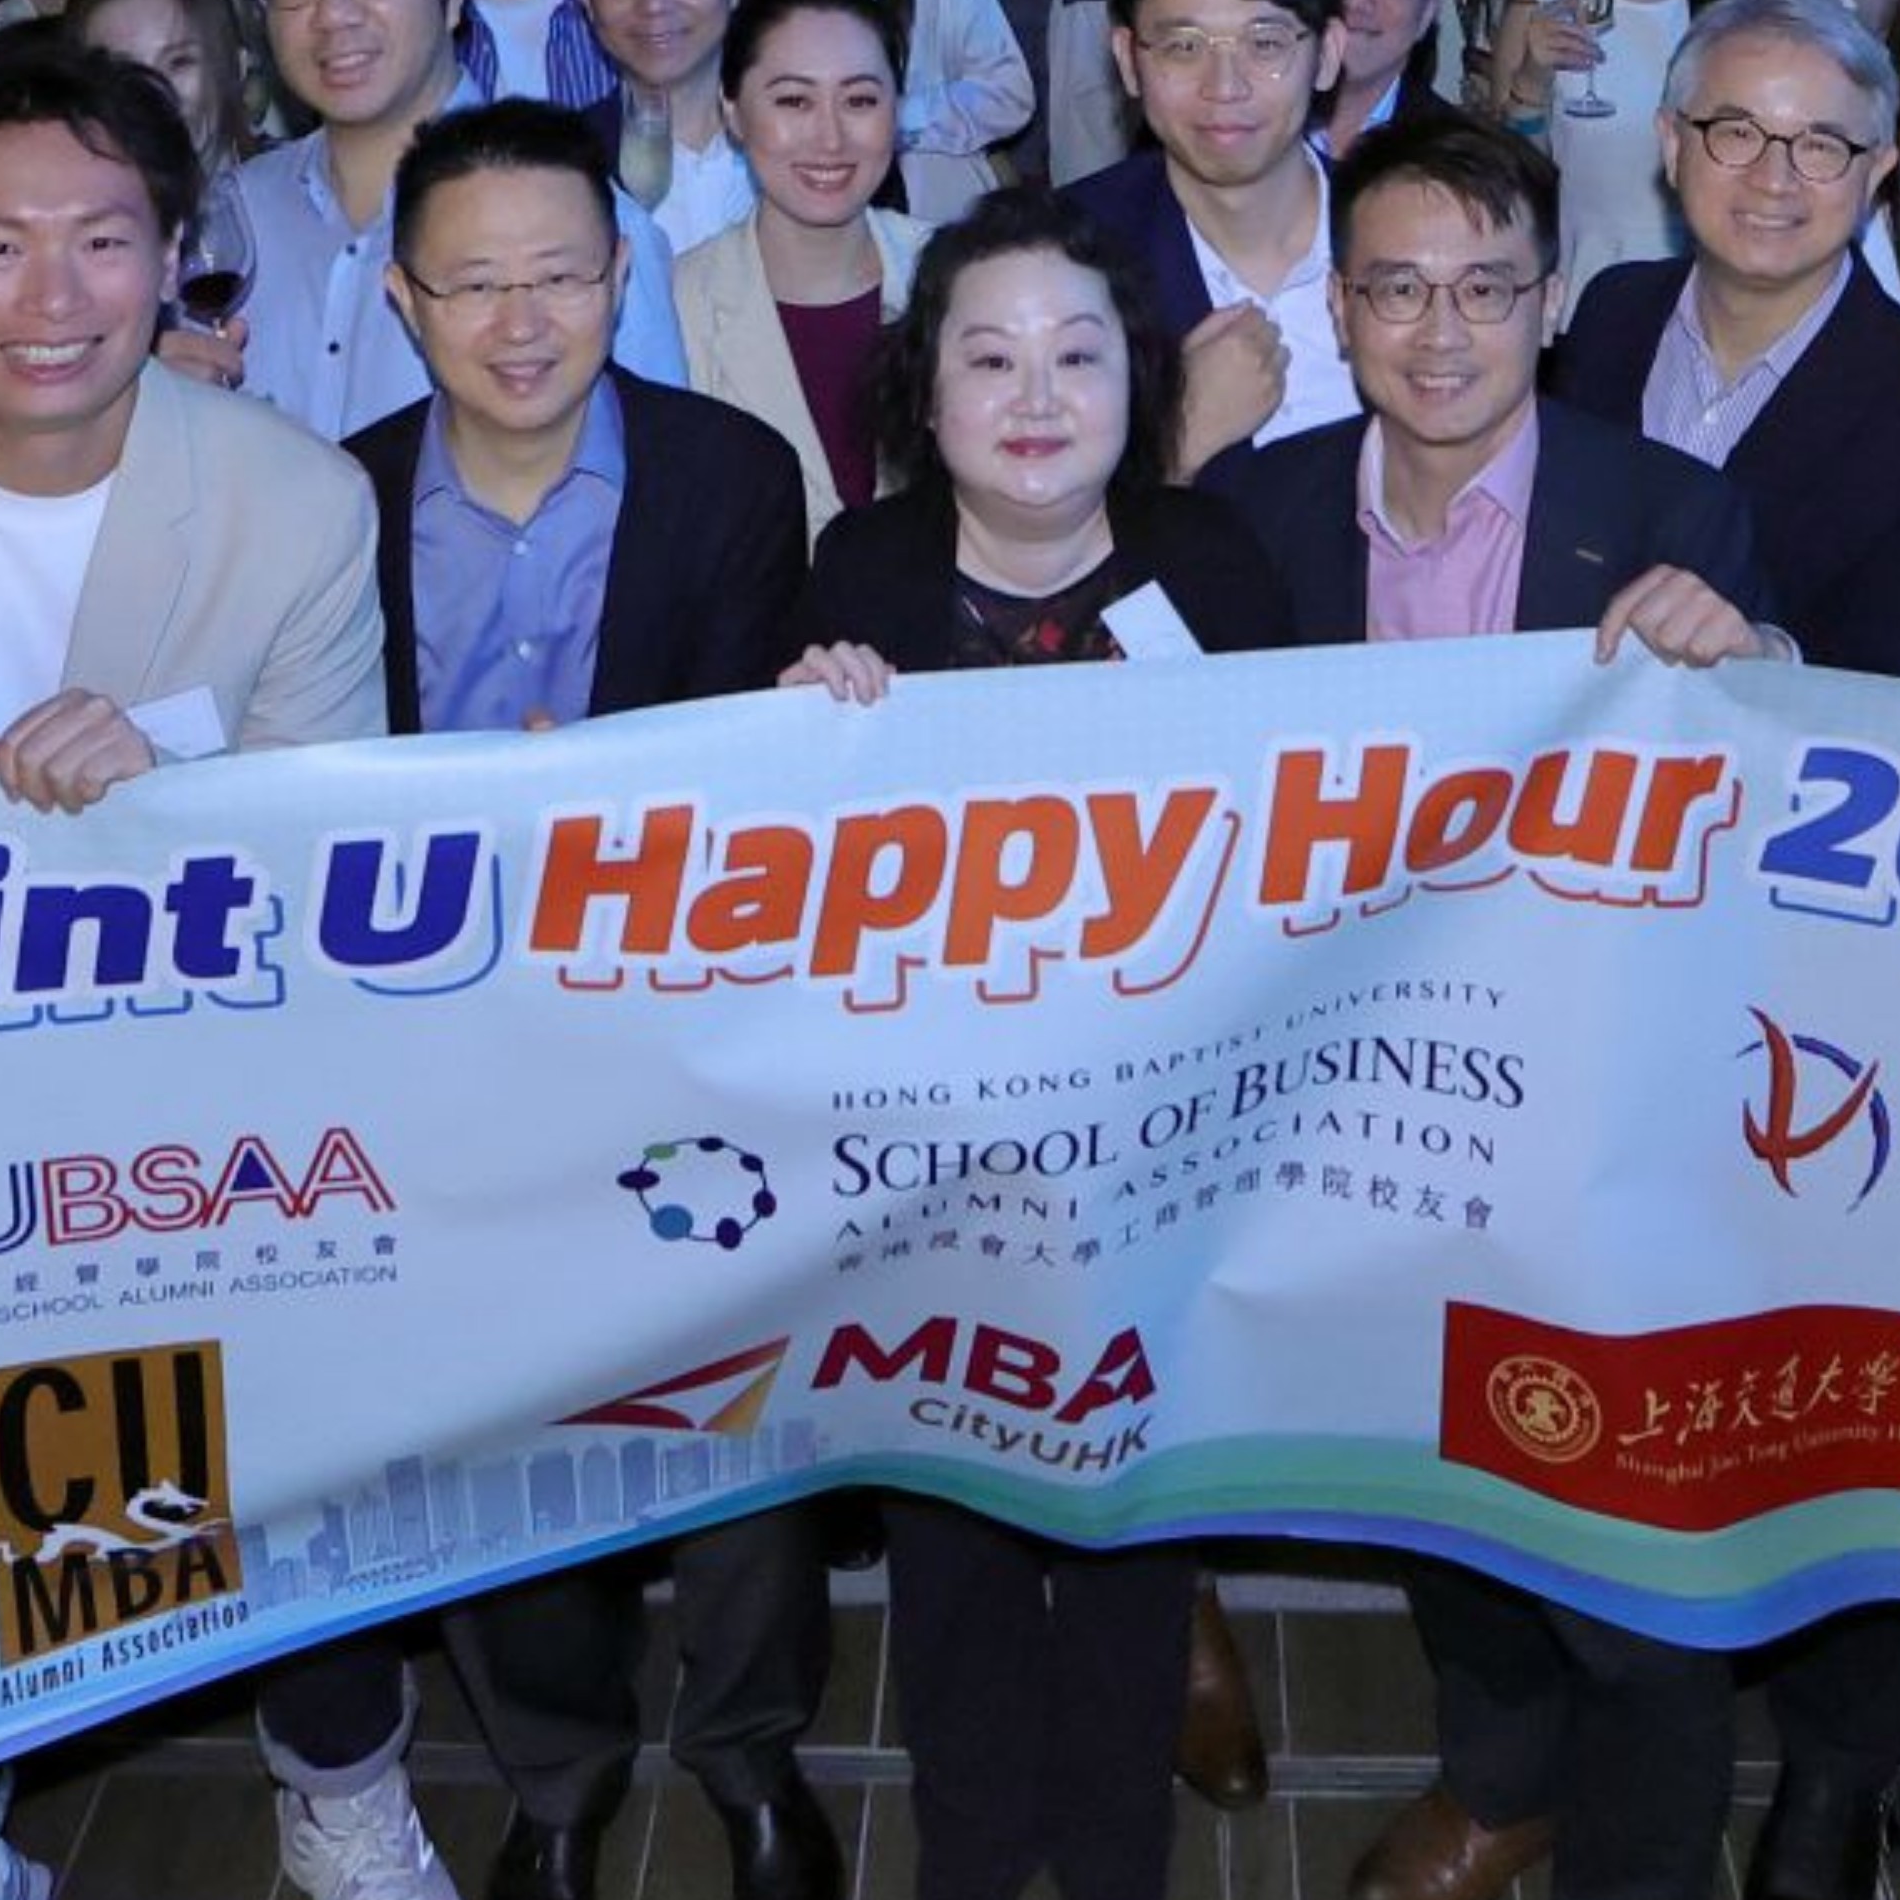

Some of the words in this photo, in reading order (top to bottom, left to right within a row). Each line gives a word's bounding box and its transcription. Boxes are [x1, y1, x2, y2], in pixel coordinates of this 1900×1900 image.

[316, 831, 481, 968] U
[526, 785, 1220, 977] Happy
[1256, 743, 1728, 906] Hour
[832, 1082, 952, 1112] HONG
[977, 1067, 1093, 1101] KONG
[1114, 1025, 1266, 1084] BAPTIST
[1284, 979, 1507, 1030] UNIVERSITY
[831, 1122, 1118, 1198] SCHOOL
[1139, 1087, 1220, 1150] OF
[1230, 1035, 1527, 1120] BUSINESS
[835, 1192, 1079, 1244] ALUMNI
[1113, 1108, 1496, 1202] ASSOCIATION
[119, 1280, 215, 1307] ALUMNI
[229, 1264, 398, 1295] ASSOCIATION
[810, 1315, 1158, 1424] MBA
[907, 1397, 1153, 1473] CityUHK
[1615, 1452, 1703, 1484] Shanghai
[1709, 1454, 1741, 1477] Jiao
[1748, 1441, 1788, 1463] Tong
[1793, 1423, 1879, 1451] University
[0, 1647, 85, 1707] Alumni
[100, 1597, 250, 1672] Association
[11, 1534, 228, 1656] MBA
